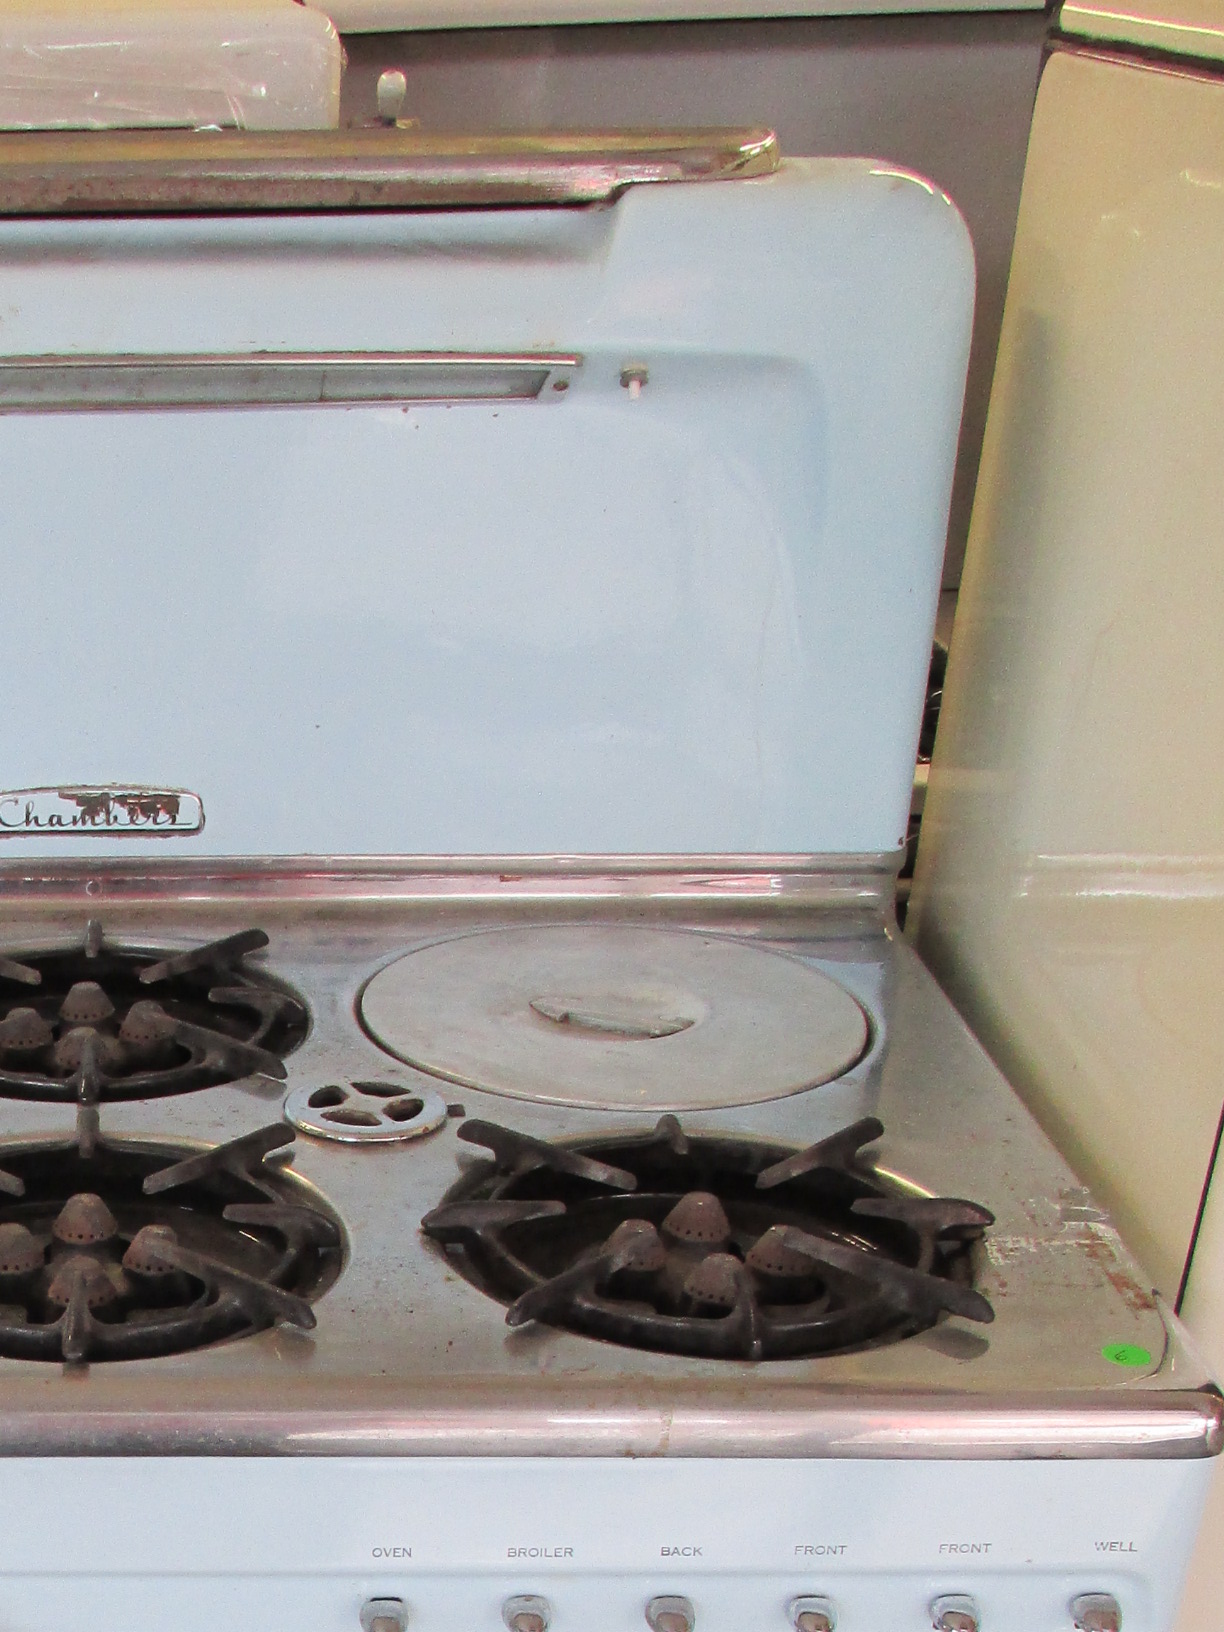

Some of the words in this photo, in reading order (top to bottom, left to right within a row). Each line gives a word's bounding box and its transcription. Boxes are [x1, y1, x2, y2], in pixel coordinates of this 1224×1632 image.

[660, 1546, 703, 1557] BACK
[794, 1545, 848, 1555] FRONT
[939, 1543, 992, 1554] FRONT
[1094, 1541, 1138, 1552] WELL
[371, 1547, 412, 1558] OVEN
[507, 1547, 574, 1558] BROILER
